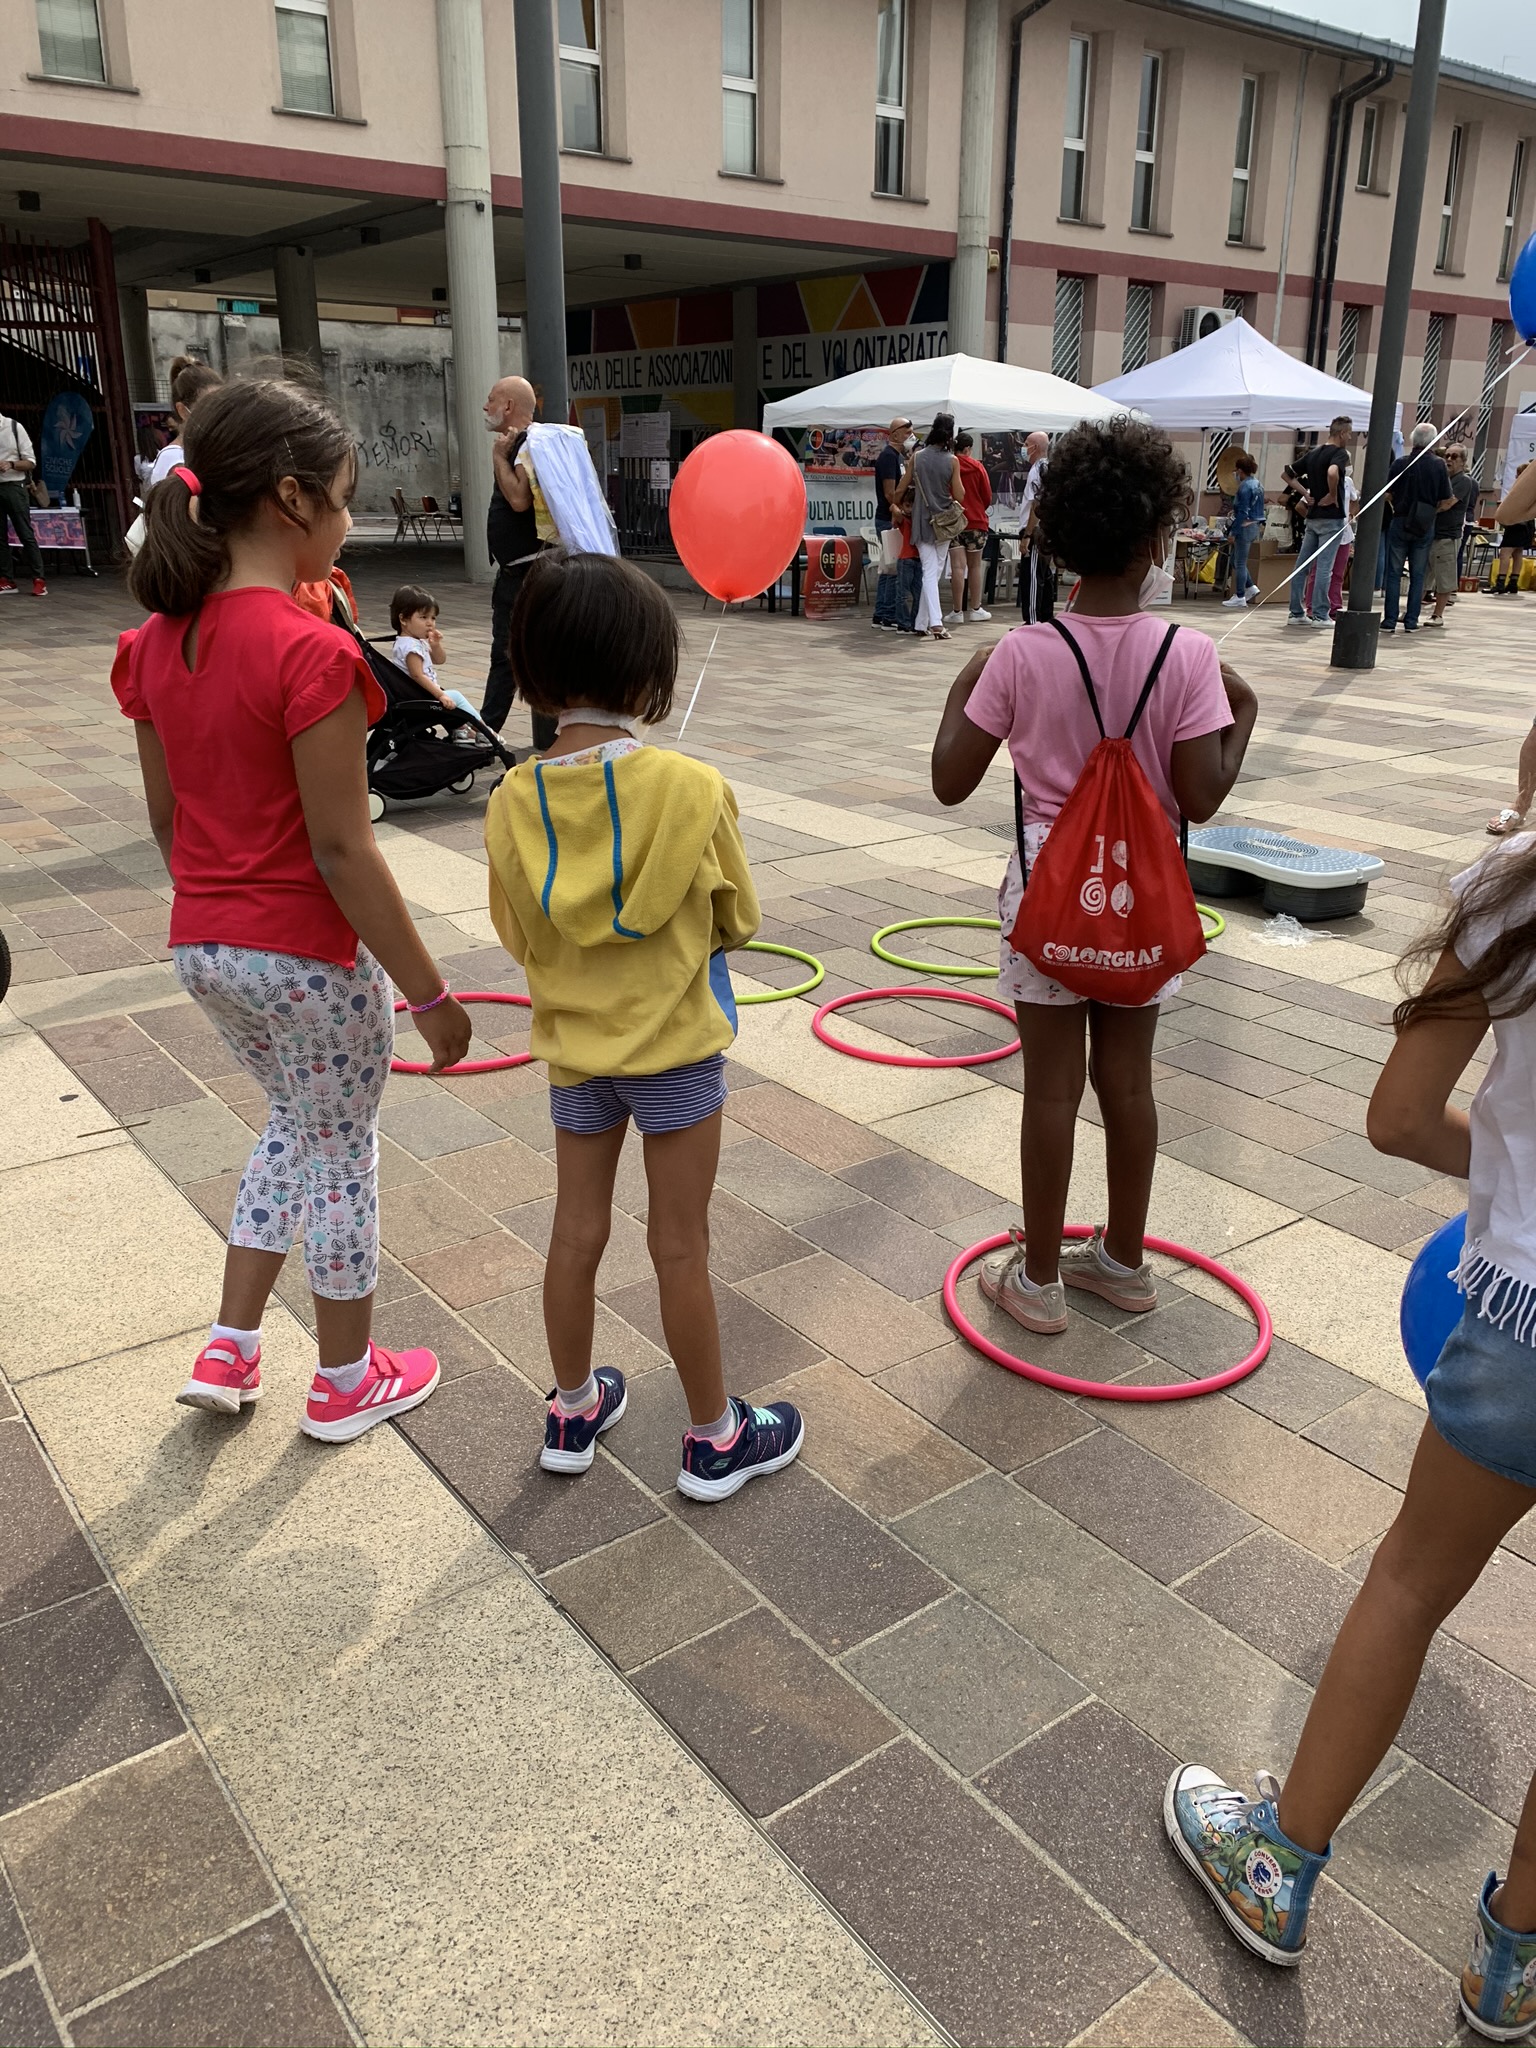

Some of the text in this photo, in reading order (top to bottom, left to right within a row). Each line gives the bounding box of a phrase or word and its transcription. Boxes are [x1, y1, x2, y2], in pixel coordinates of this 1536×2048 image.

[571, 360, 601, 391] CASA
[606, 357, 642, 389] DELLE
[648, 348, 732, 387] ASSOCIAZIONI
[763, 345, 772, 380] E
[783, 342, 812, 380] DEL
[45, 464, 71, 474] SCUOLE
[838, 500, 874, 520] DELLO
[822, 553, 849, 565] GEAS
[1043, 941, 1163, 968] COLORGRAF
[1254, 1850, 1280, 1878] CONVERSE
